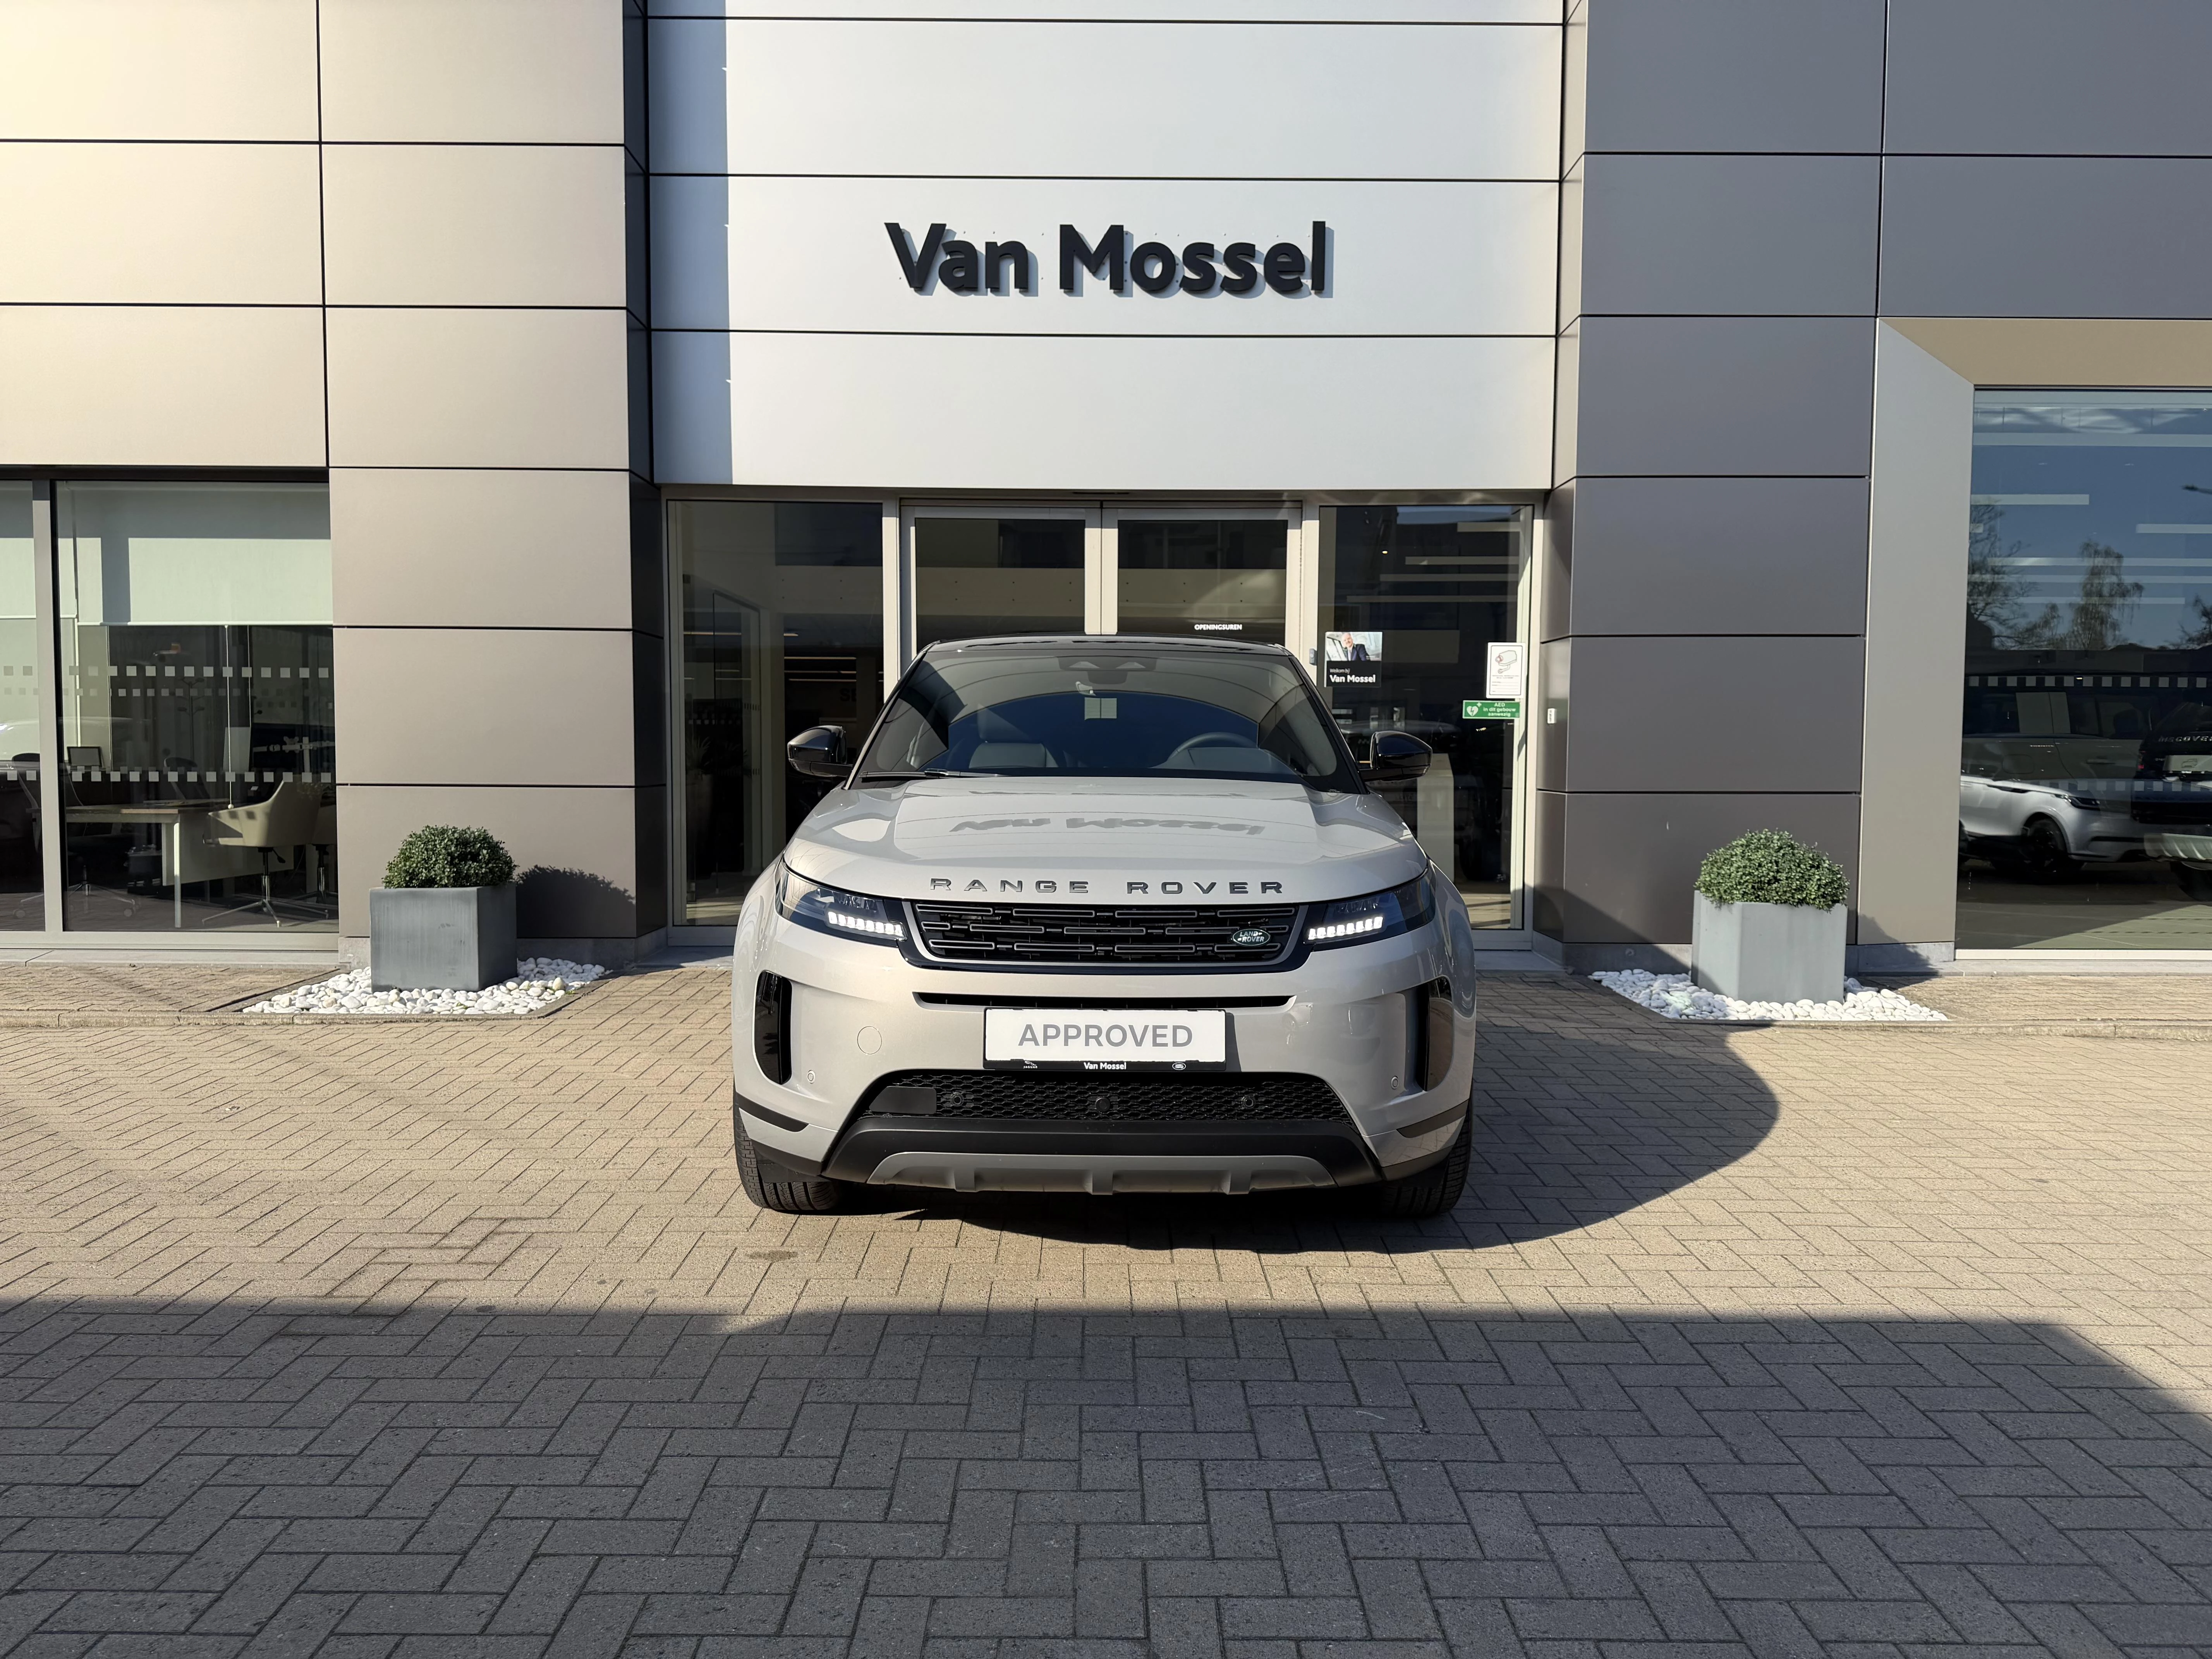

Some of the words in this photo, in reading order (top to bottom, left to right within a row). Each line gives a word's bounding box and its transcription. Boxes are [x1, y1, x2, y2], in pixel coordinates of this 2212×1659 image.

[884, 223, 1029, 292] Van
[1060, 221, 1326, 293] Mossel
[1347, 674, 1376, 682] Mossel
[930, 878, 1089, 893] RANGE
[1127, 881, 1283, 894] ROVER
[1018, 1024, 1192, 1047] APPROVED
